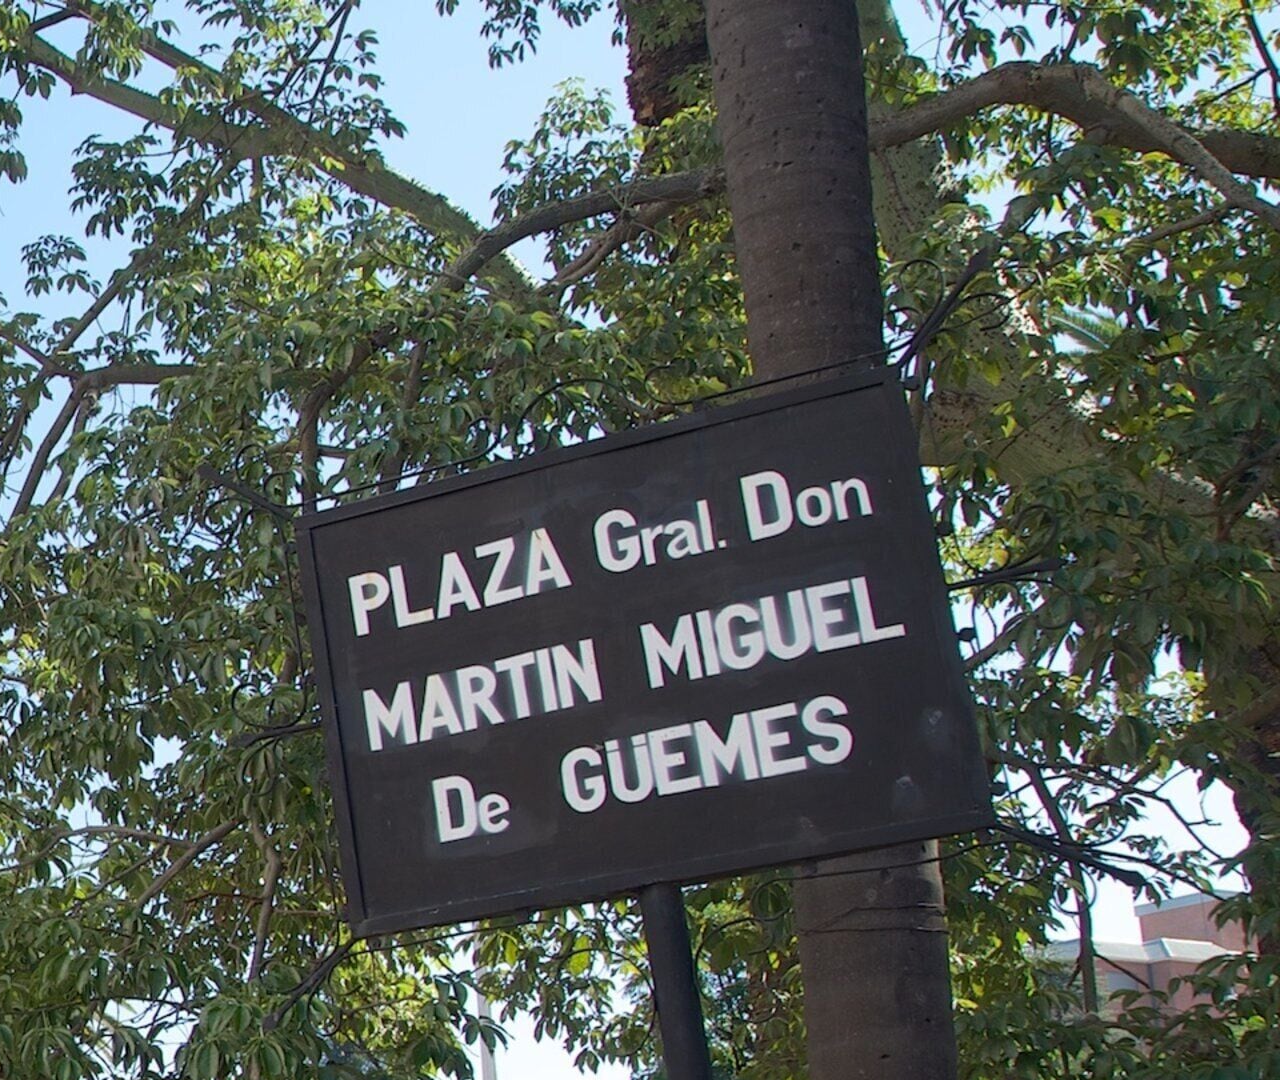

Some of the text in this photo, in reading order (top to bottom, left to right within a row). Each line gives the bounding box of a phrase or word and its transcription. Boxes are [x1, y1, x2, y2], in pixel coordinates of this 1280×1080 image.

[349, 472, 872, 635] PLAZA Gral. Don
[363, 577, 905, 751] MARTIN MIGUEL
[432, 776, 509, 842] De
